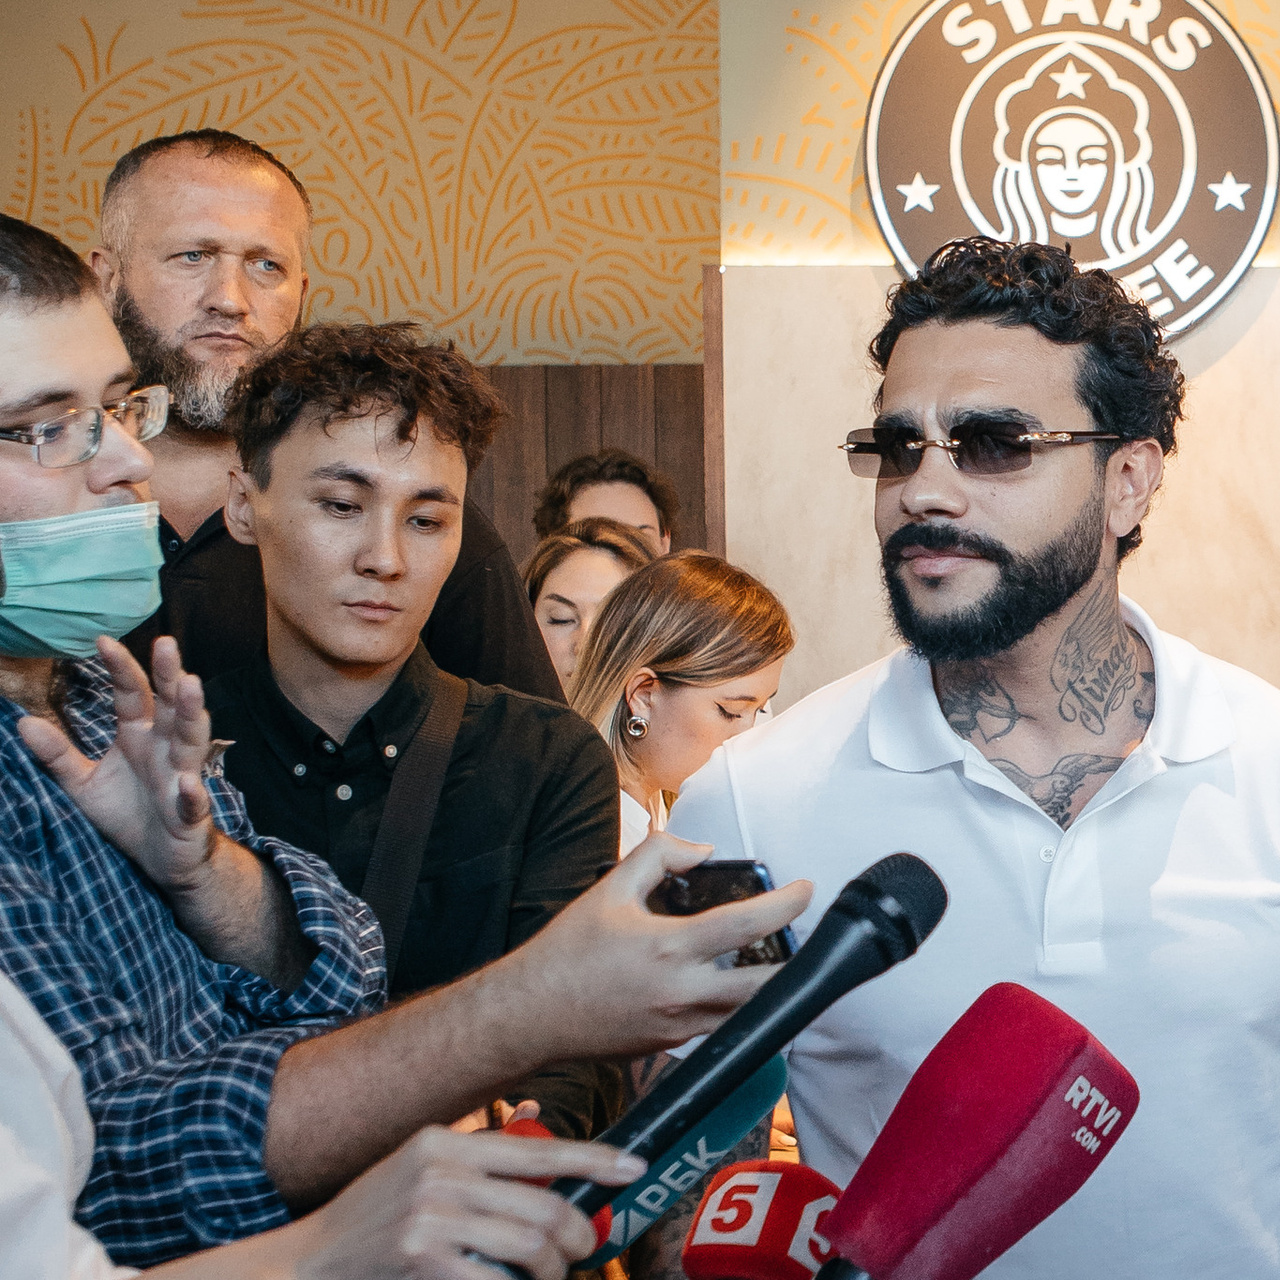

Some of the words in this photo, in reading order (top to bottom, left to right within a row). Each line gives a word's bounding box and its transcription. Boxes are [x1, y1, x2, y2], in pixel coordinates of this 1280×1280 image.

[1063, 1075, 1122, 1137] RTVI
[1071, 1126, 1102, 1155] .COM
[634, 1136, 729, 1214] РБК
[711, 1185, 760, 1234] 5
